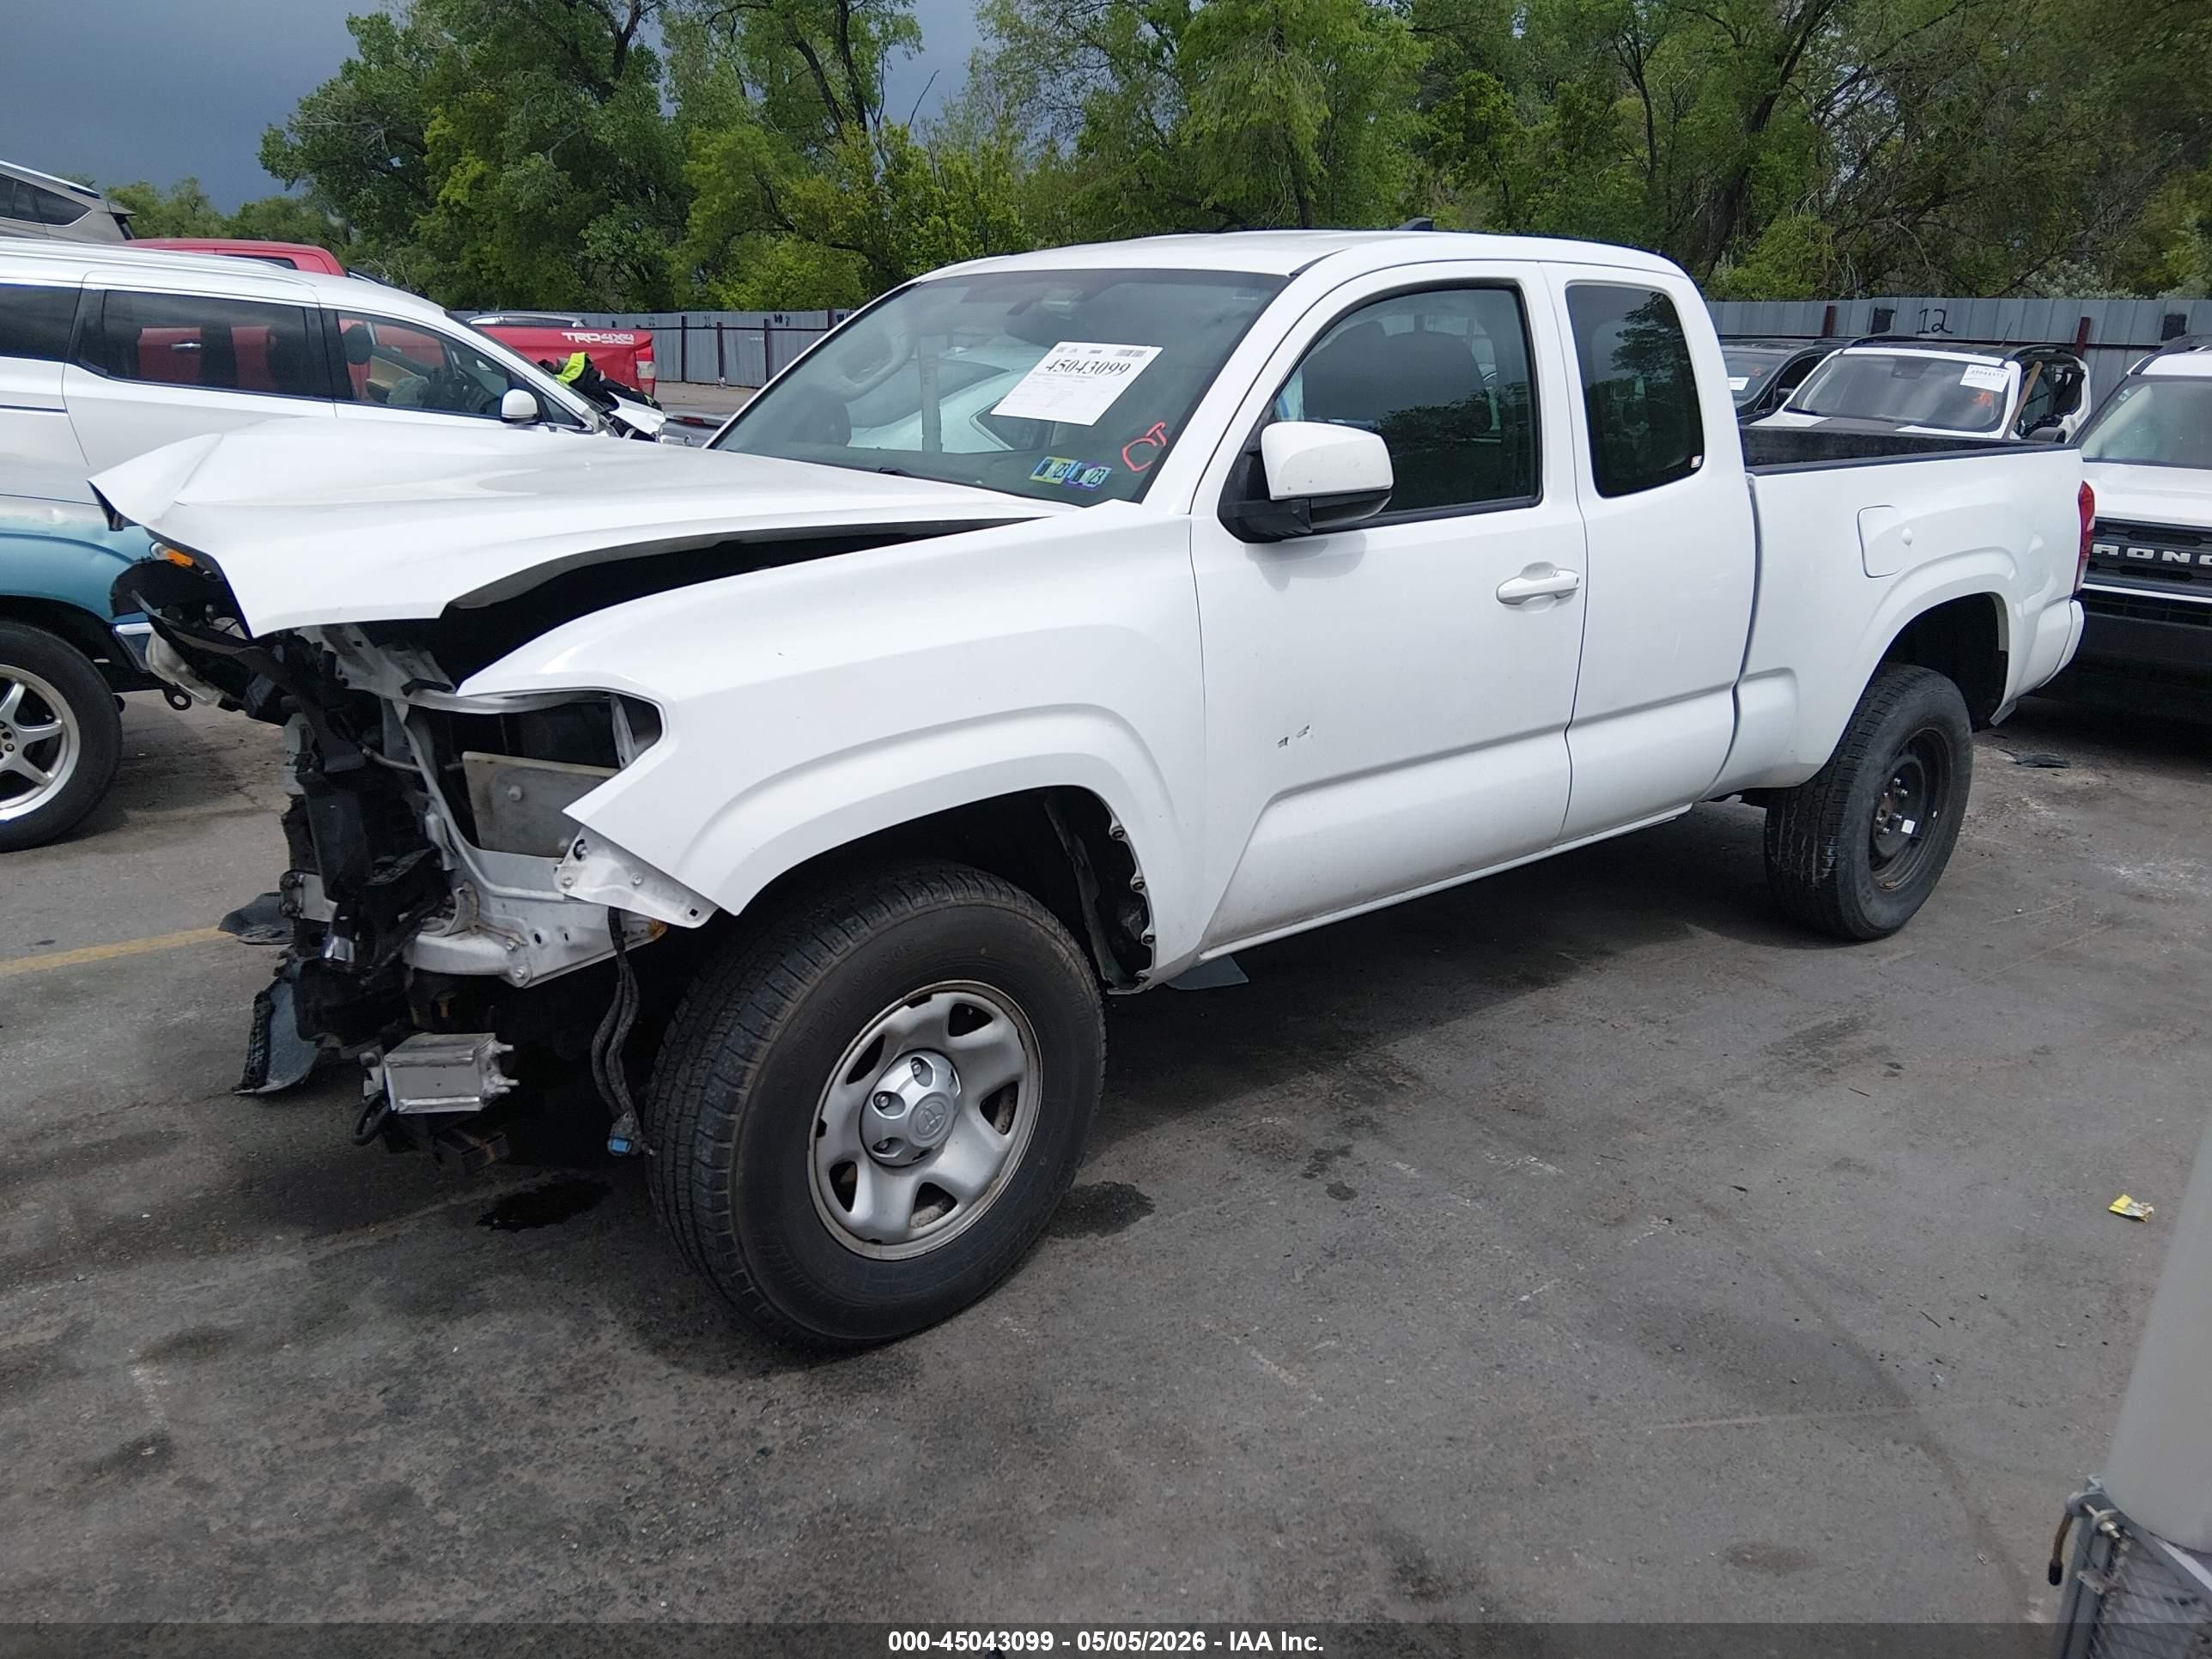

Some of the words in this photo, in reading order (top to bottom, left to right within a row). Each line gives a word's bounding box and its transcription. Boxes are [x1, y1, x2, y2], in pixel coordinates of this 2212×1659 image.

[1917, 308, 1954, 334] 12
[561, 331, 601, 343] TRD
[1045, 358, 1132, 376] 45043099
